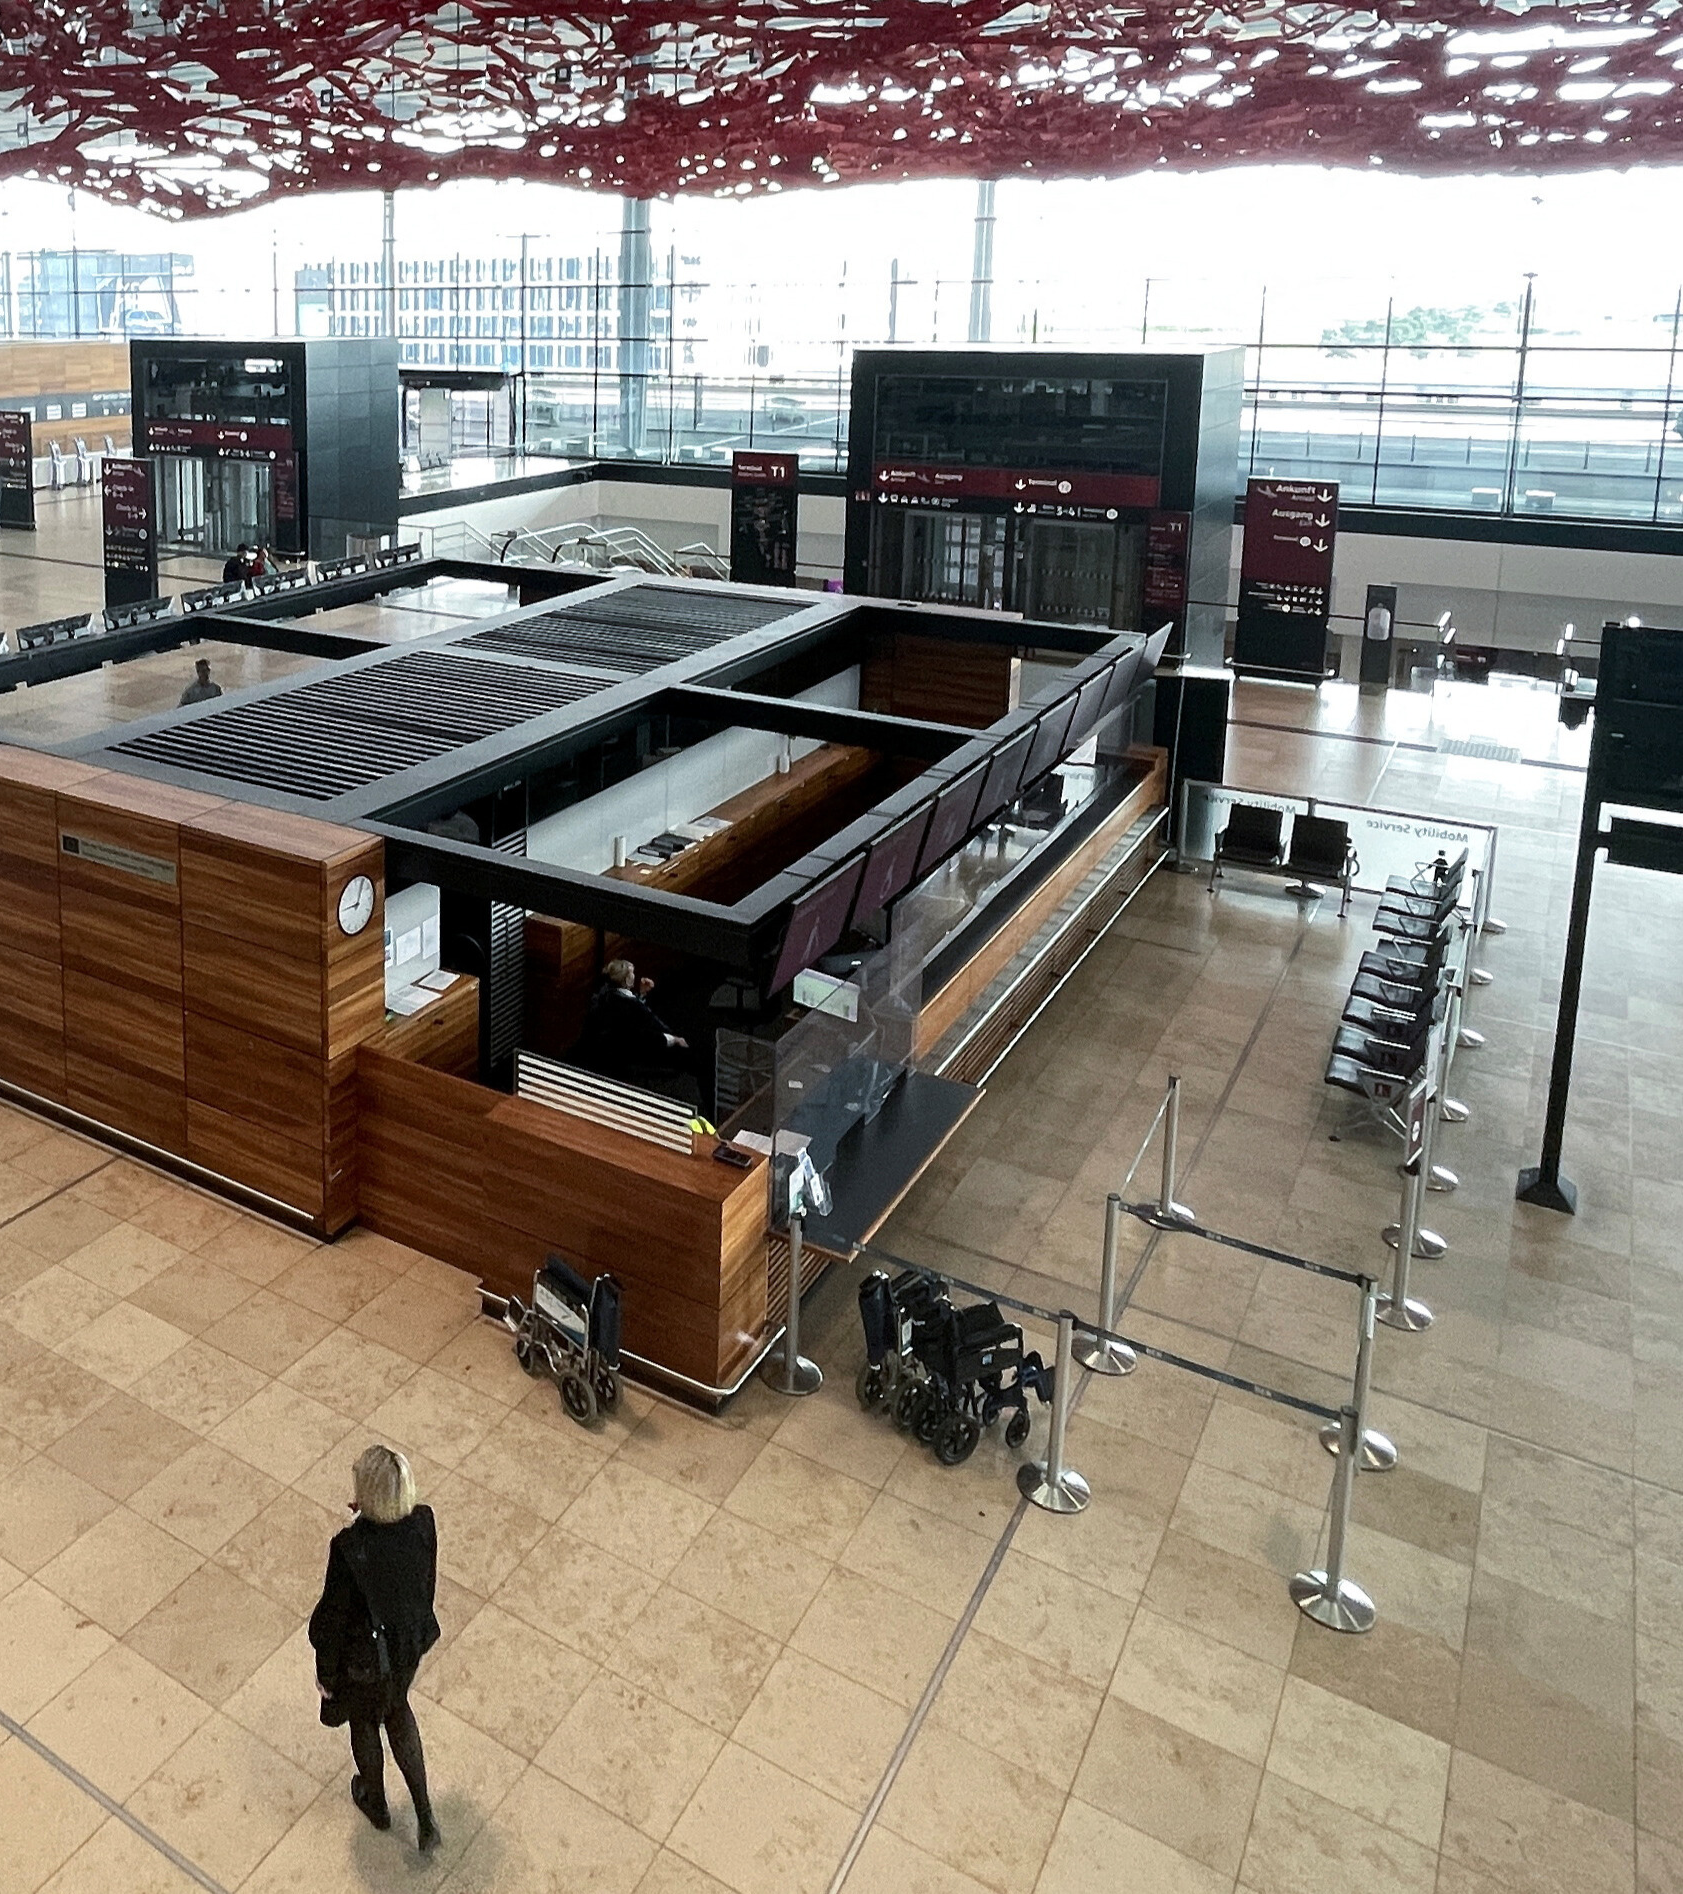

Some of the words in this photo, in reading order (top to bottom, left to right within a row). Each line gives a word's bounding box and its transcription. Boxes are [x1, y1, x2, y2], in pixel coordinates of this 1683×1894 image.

[770, 465, 786, 478] T1
[1275, 484, 1317, 495] Ankunft
[1271, 508, 1314, 520] Ausgang
